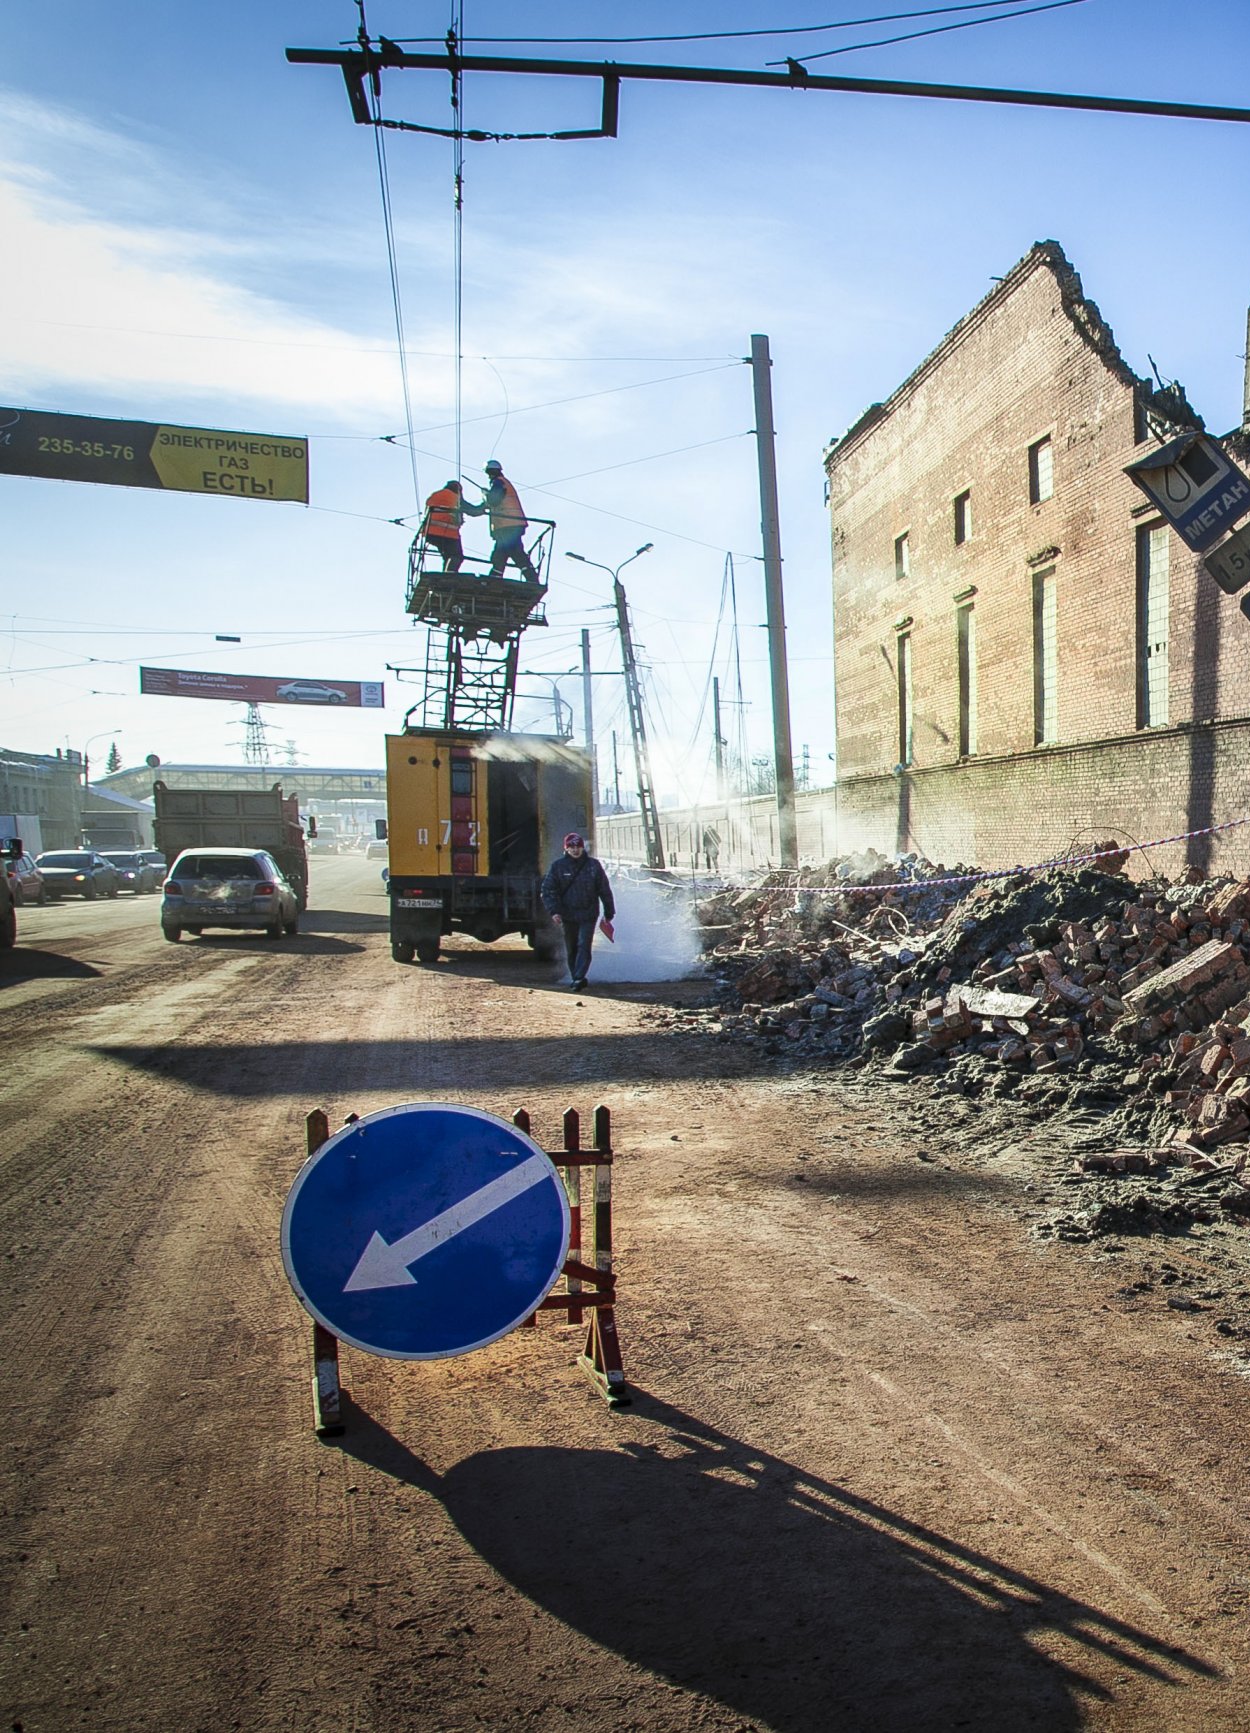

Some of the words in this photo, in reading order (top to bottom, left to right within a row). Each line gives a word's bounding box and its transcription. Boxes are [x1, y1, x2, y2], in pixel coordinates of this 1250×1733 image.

[38, 436, 135, 460] 235-35-76
[159, 433, 305, 459] ЭЛЕКТРИЧЕСТВО
[218, 455, 250, 470] ГАЗ
[202, 471, 274, 495] ЕСТЬ!
[1184, 480, 1249, 540] МЕТАН
[177, 672, 201, 681] Toyota
